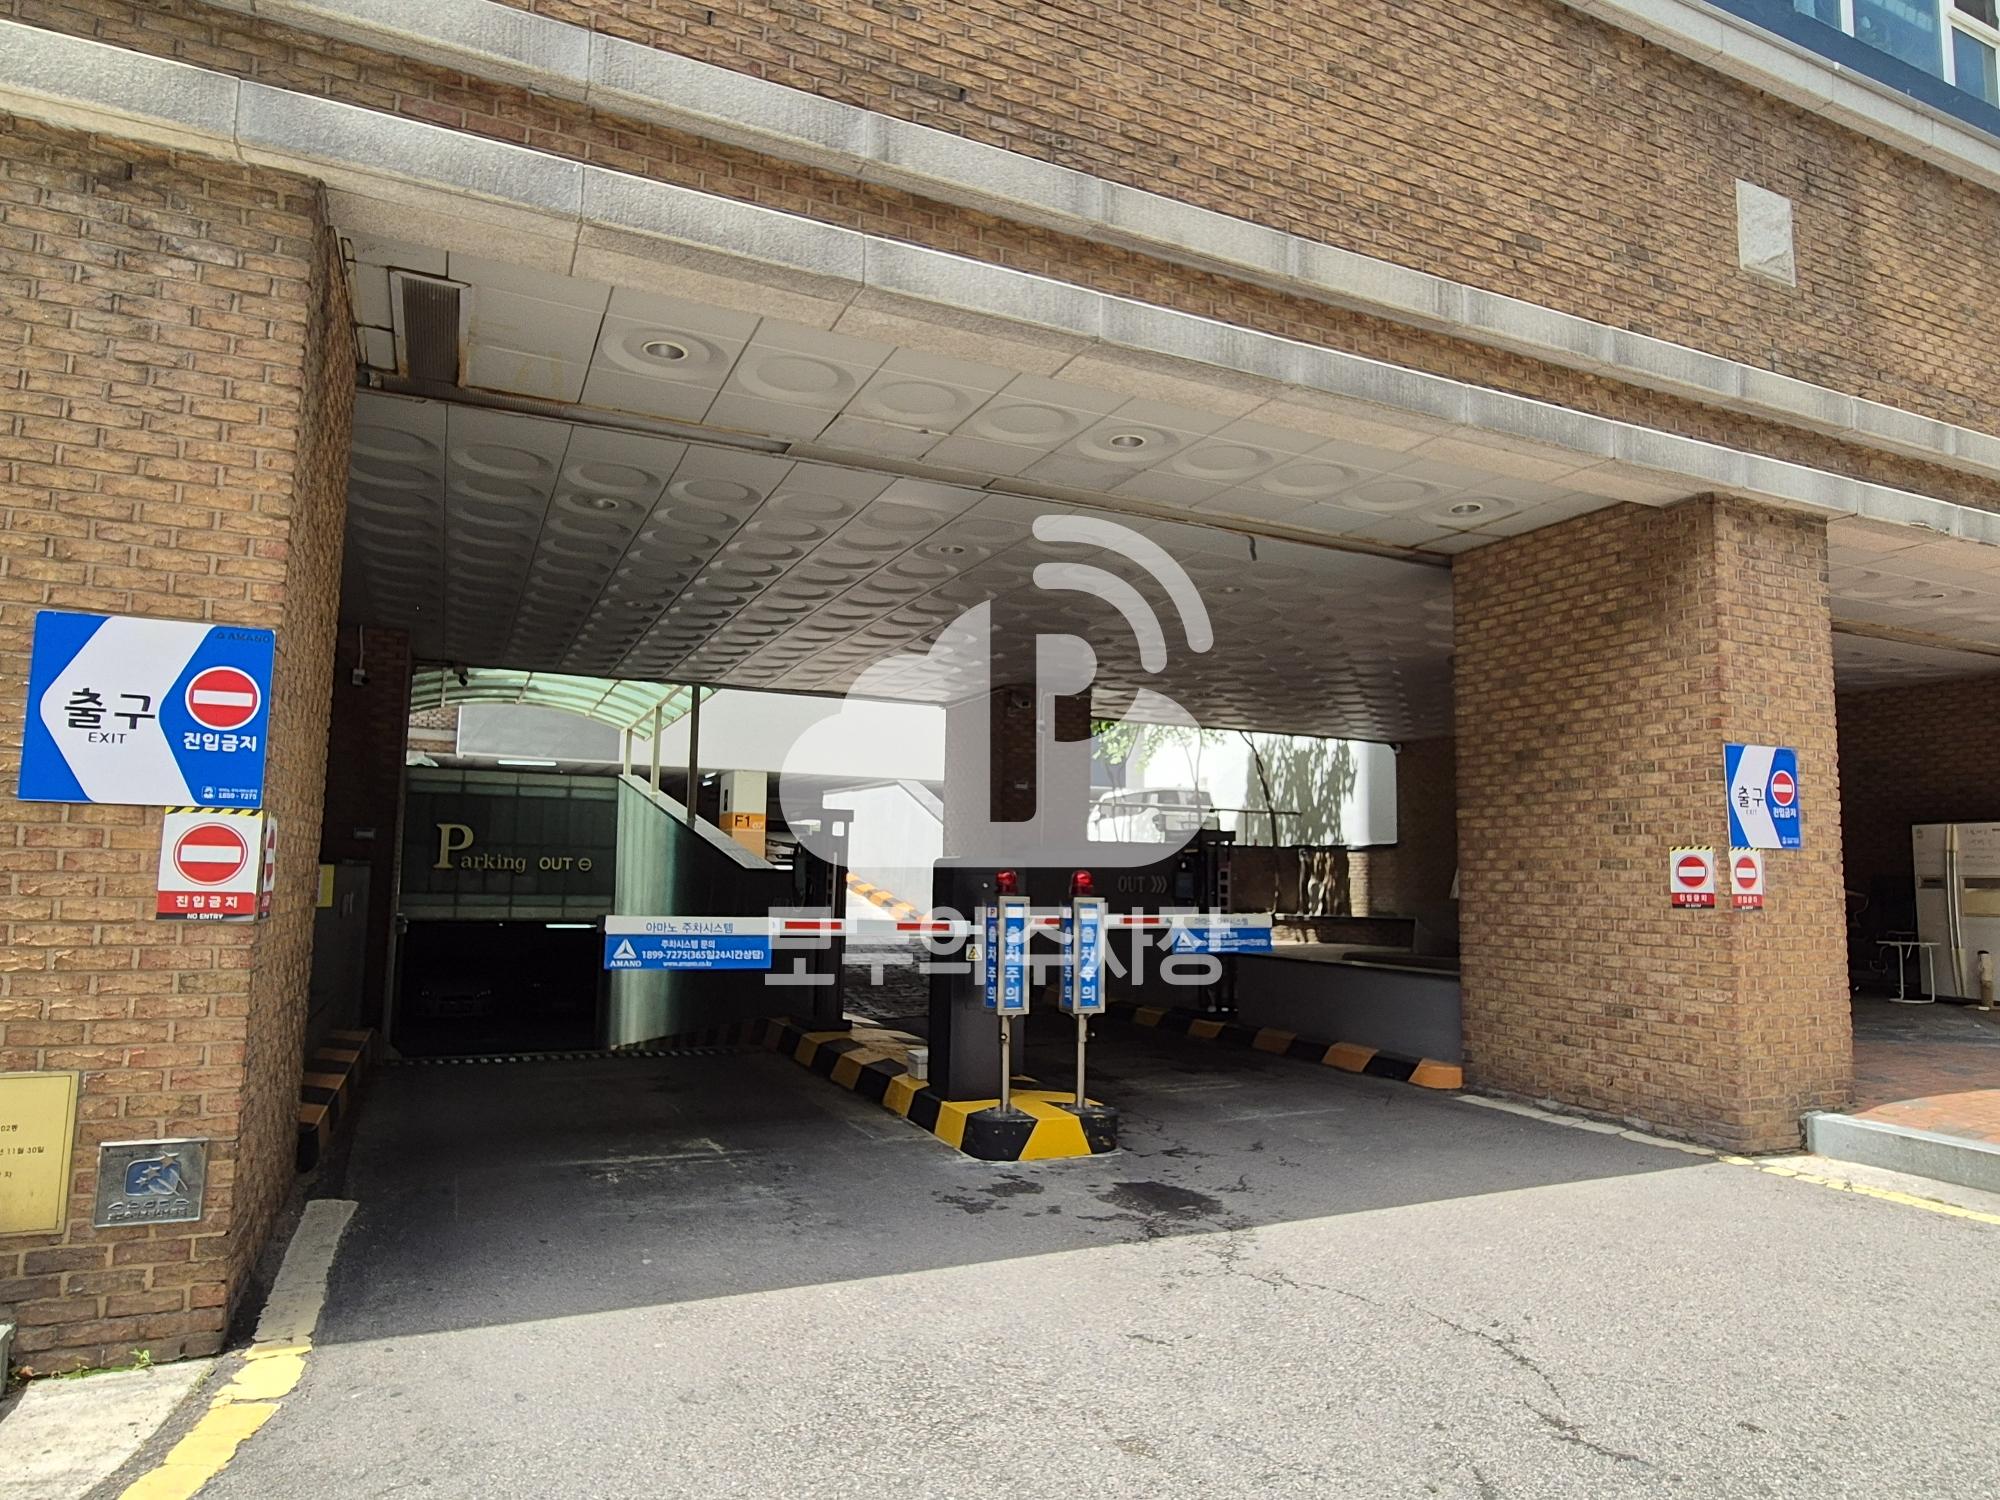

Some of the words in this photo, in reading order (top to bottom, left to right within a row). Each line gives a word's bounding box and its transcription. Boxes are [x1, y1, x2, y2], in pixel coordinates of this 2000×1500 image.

[64, 687, 156, 730] 출구
[88, 731, 127, 744] EXIT
[183, 732, 258, 752] 진입금지
[1738, 785, 1764, 808] 출구
[735, 815, 750, 828] F1
[433, 823, 527, 873] Parking
[539, 856, 574, 871] OUT
[1118, 875, 1146, 893] OUT
[175, 895, 238, 909] 진입금지
[199, 913, 224, 921] ENTRY
[646, 921, 678, 933] 아마노
[682, 921, 734, 934] 주차시스템
[610, 959, 642, 967] AMANO
